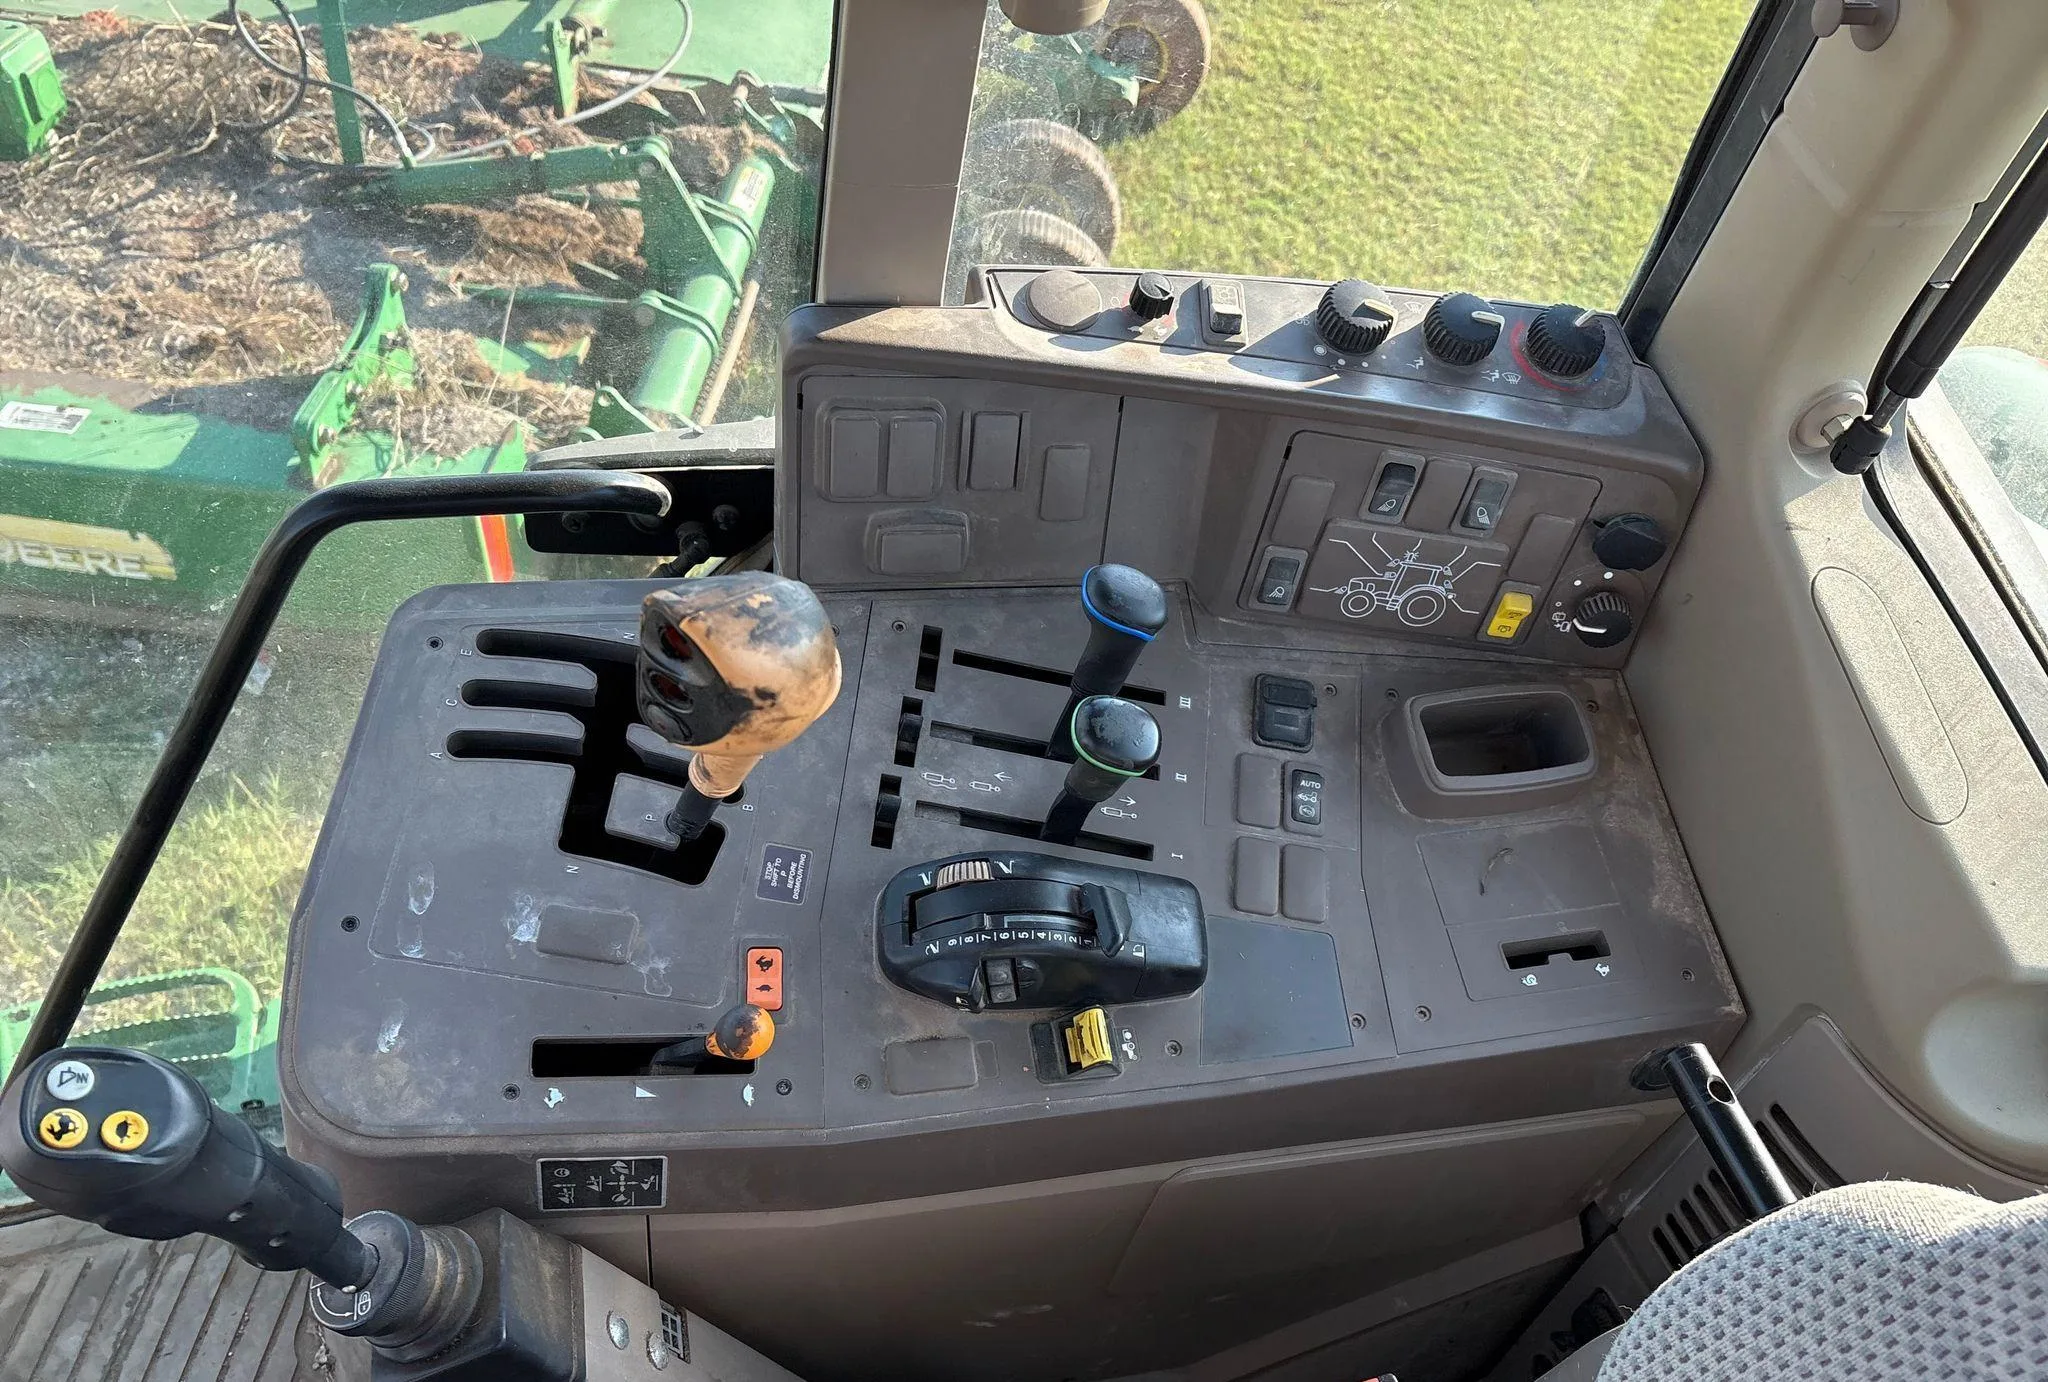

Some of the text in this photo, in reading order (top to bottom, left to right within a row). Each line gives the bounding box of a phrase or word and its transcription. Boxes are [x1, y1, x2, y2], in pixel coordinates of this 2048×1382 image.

[460, 648, 472, 656] E
[445, 698, 458, 707] C
[430, 752, 442, 760] A
[1299, 779, 1321, 789] AUTO
[742, 803, 754, 812] B
[645, 814, 657, 822] P
[764, 861, 772, 880] STOP
[770, 857, 782, 887] SHIFT TO
[786, 861, 798, 889] BEFORE
[792, 853, 807, 900] DISMOUNTING
[964, 935, 974, 943] 8
[981, 934, 991, 942] 7
[999, 932, 1010, 940] 6
[1017, 931, 1029, 939] 5
[1036, 931, 1047, 939] 4
[1053, 933, 1062, 941] 3
[948, 938, 958, 946] 9
